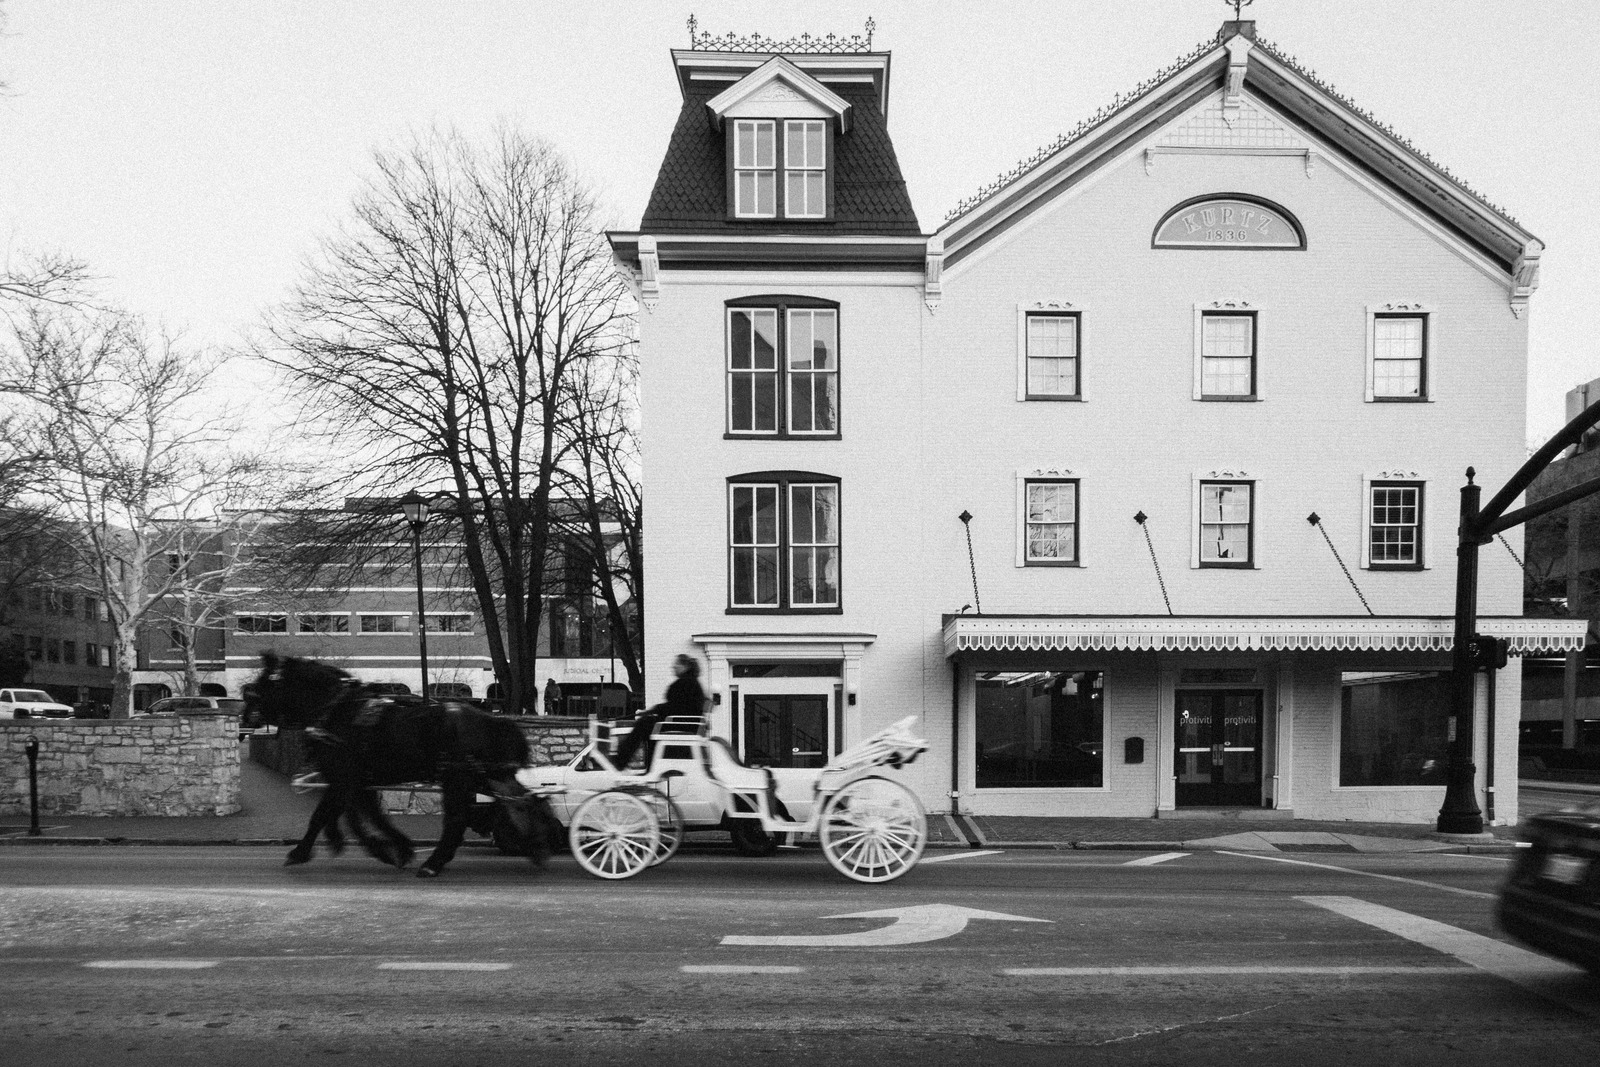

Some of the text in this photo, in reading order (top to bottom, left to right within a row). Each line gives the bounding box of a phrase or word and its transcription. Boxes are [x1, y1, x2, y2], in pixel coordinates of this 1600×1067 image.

[1182, 207, 1273, 234] KURTZ
[1206, 229, 1246, 241] 1836
[1180, 716, 1212, 727] protiviti
[1224, 716, 1256, 727] protiviti
